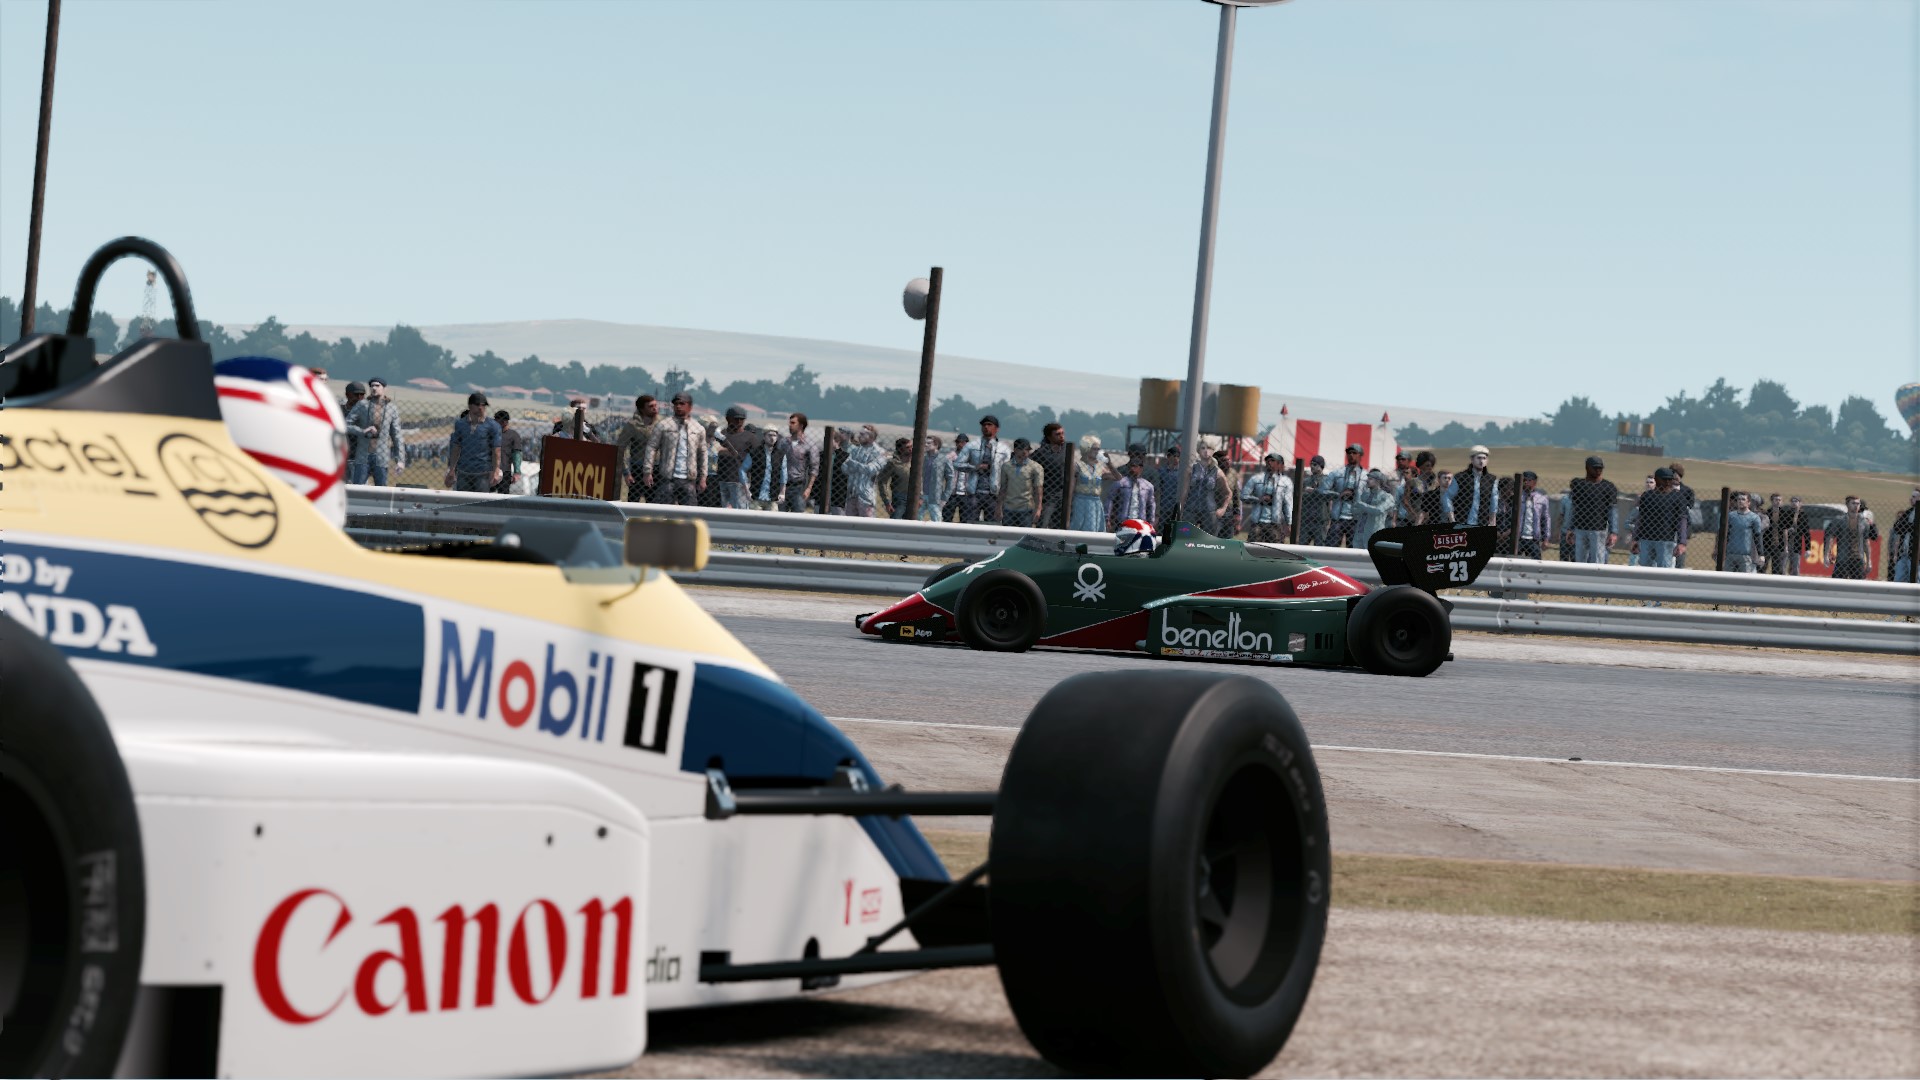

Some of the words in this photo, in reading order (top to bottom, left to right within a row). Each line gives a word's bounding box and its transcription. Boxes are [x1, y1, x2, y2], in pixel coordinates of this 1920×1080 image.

[552, 459, 606, 499] BOSCH
[1437, 535, 1464, 545] SISLEY
[34, 557, 74, 594] by
[1448, 560, 1469, 582] 23
[1161, 607, 1273, 652] benetton
[435, 618, 614, 743] Mobil
[253, 887, 633, 1026] Canon
